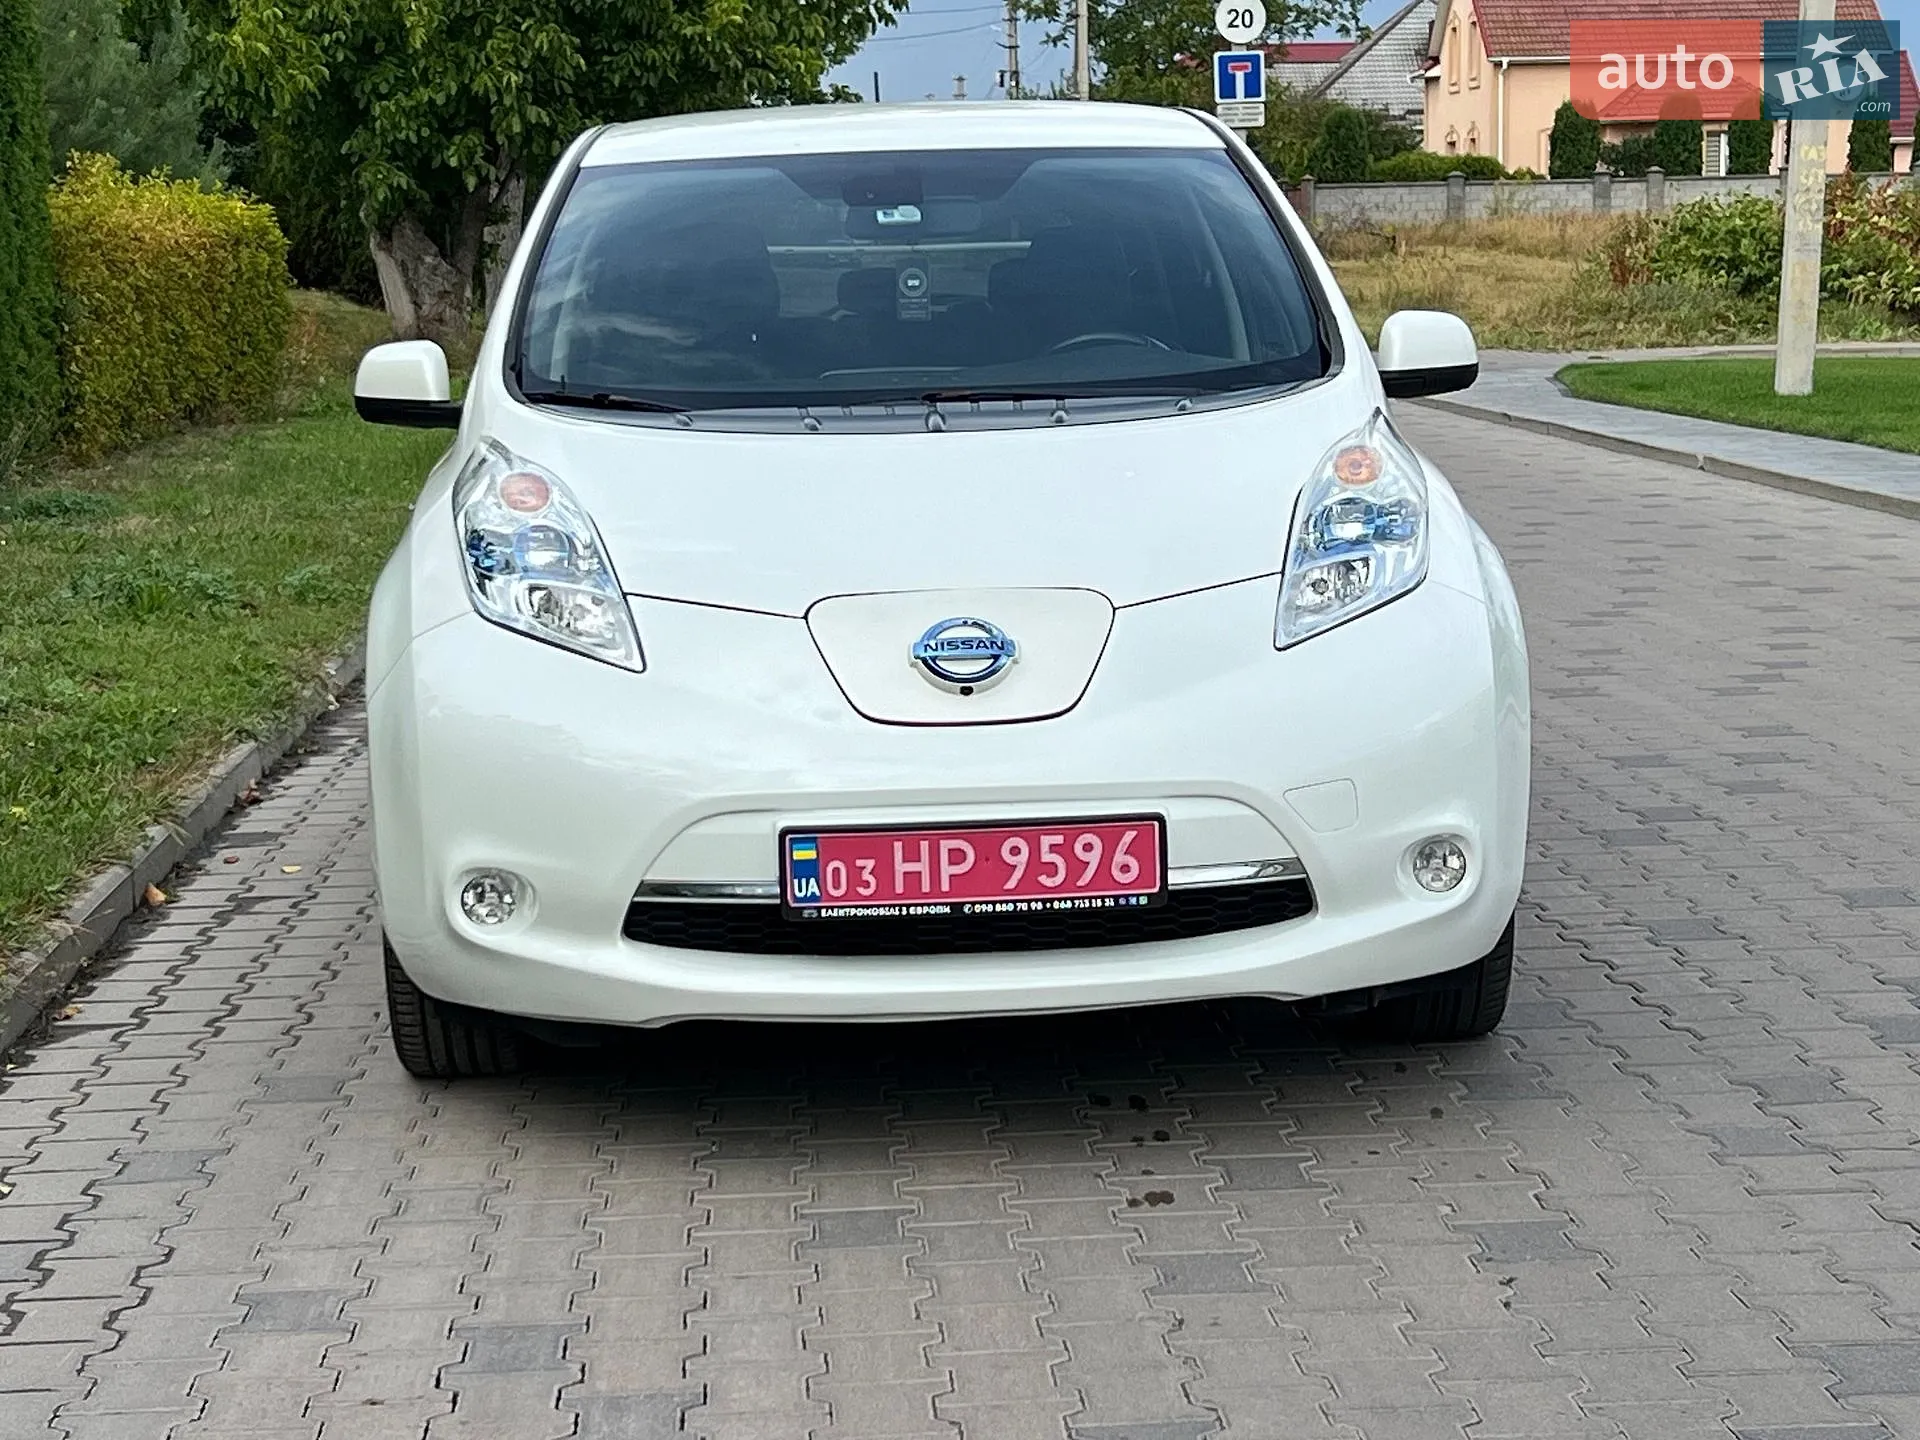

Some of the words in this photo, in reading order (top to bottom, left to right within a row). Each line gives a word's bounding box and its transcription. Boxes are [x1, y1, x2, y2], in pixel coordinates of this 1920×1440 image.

[1227, 9, 1254, 29] 20
[924, 640, 1005, 653] NISSAN
[825, 858, 877, 897] 03
[893, 839, 976, 894] HP
[999, 830, 1141, 890] 9596
[793, 878, 821, 897] UA
